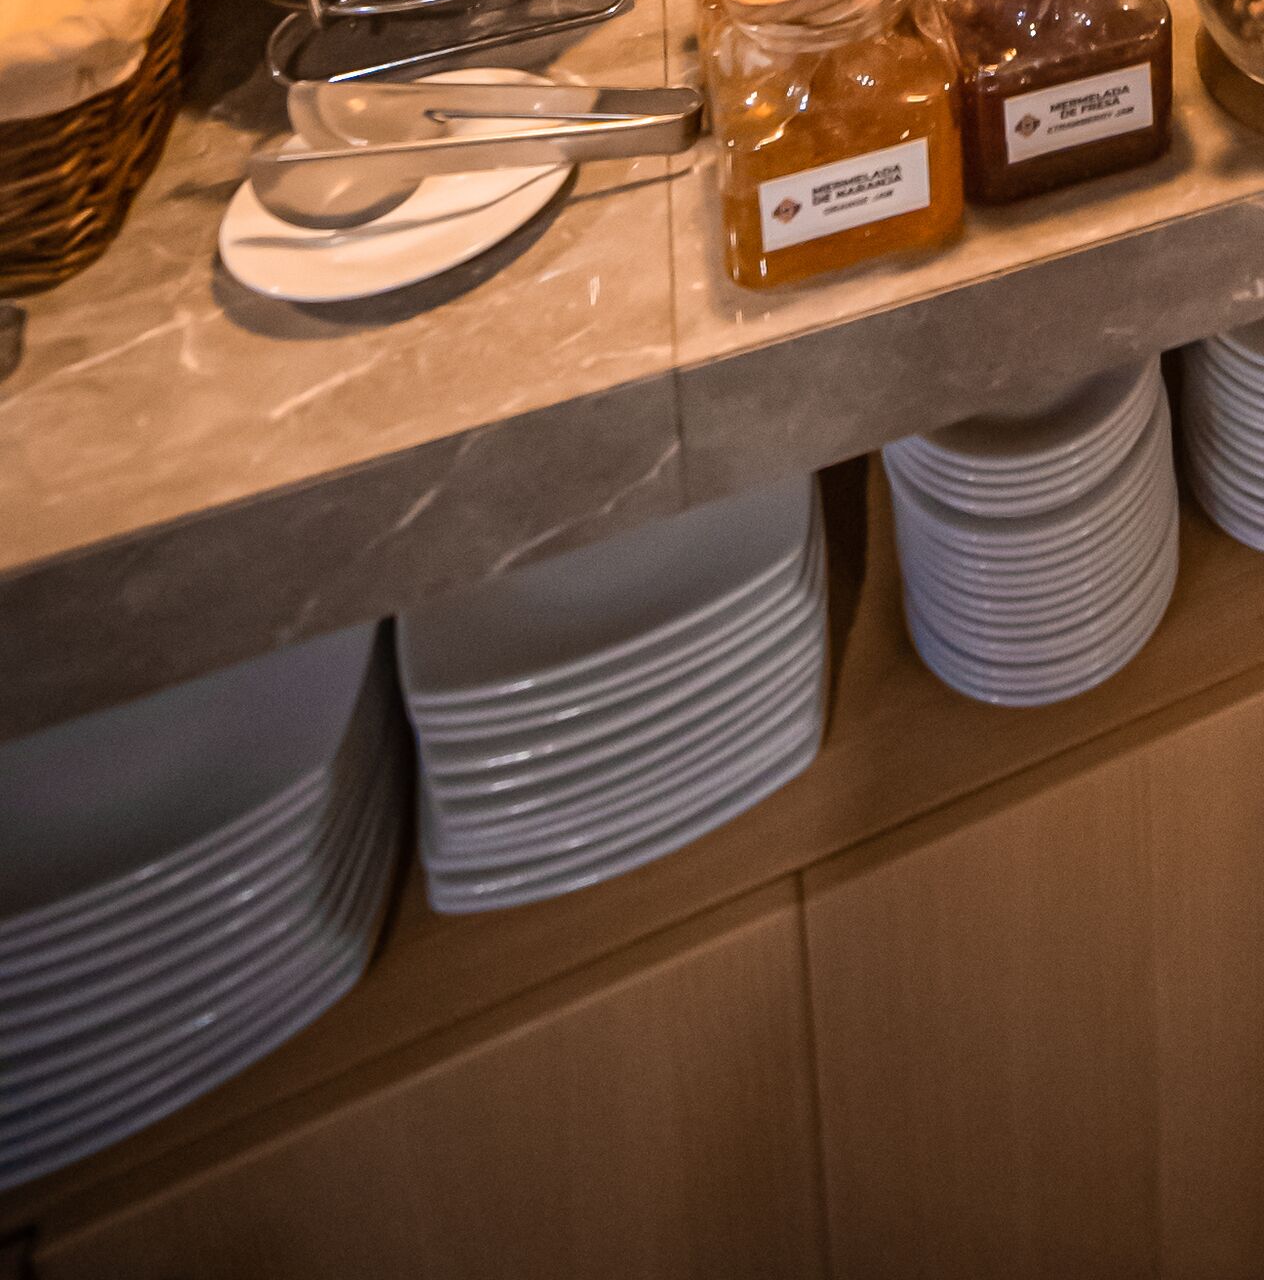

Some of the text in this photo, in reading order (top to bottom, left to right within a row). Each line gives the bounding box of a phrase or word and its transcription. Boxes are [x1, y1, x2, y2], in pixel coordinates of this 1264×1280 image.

[1049, 84, 1131, 114] MERMELADA
[1060, 97, 1121, 121] DE FRESA
[812, 163, 902, 194] MERMELADA
[811, 192, 831, 207] DE
